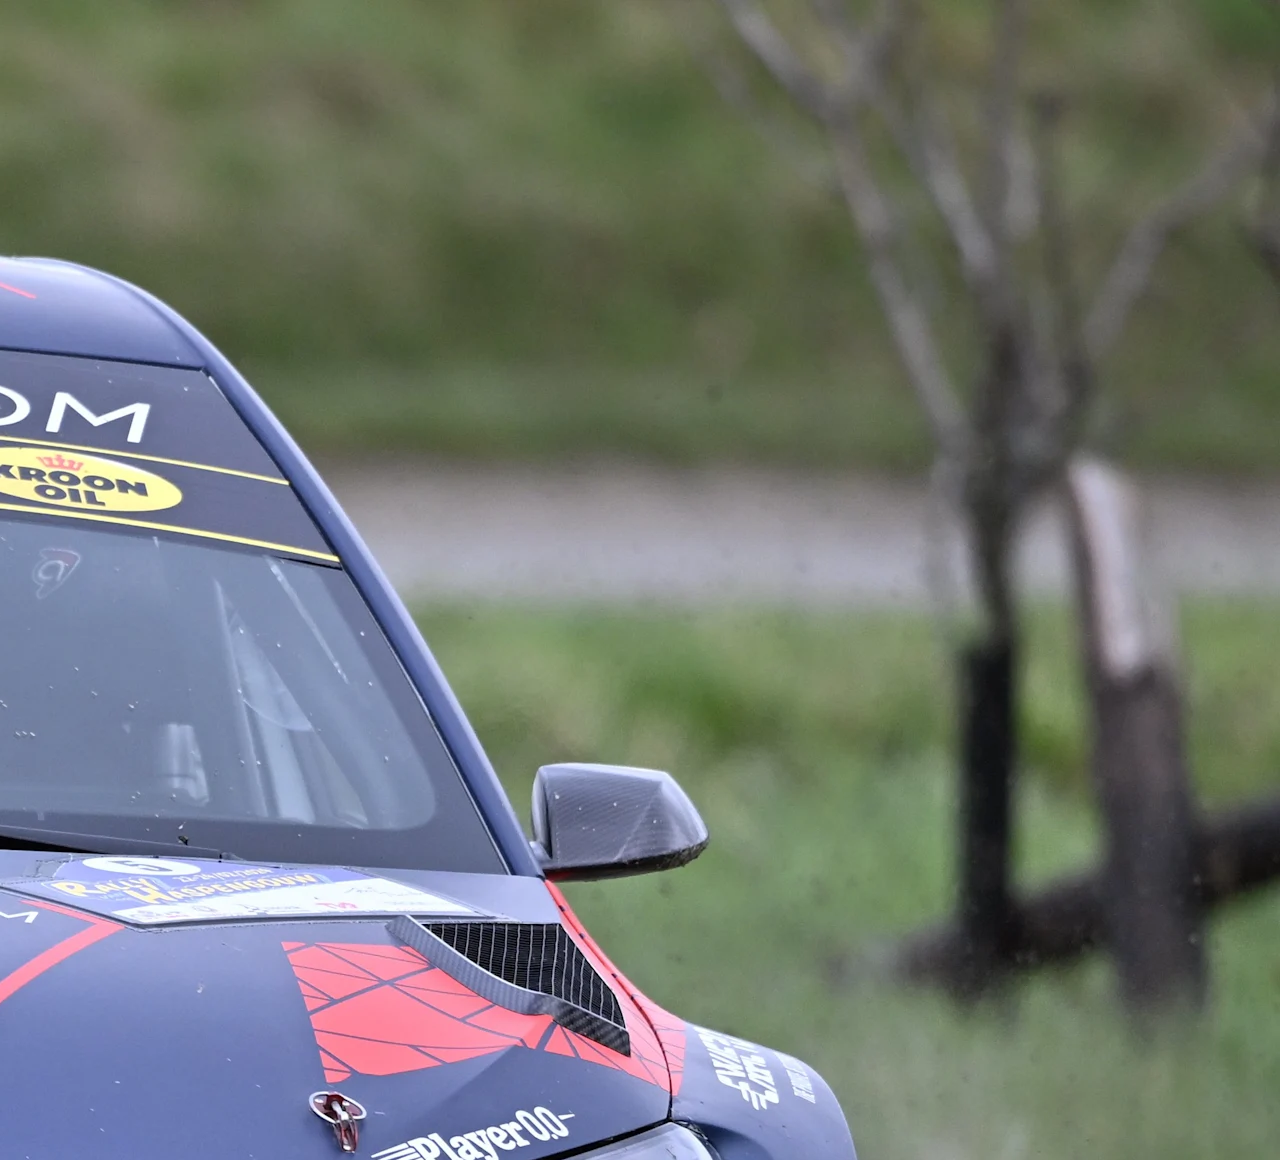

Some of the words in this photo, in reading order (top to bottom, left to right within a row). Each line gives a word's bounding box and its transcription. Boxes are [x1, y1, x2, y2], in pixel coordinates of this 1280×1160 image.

[33, 483, 107, 508] OIL
[107, 859, 174, 872] 5
[50, 876, 157, 898] RALLY
[125, 873, 319, 905] HASPENGOUW
